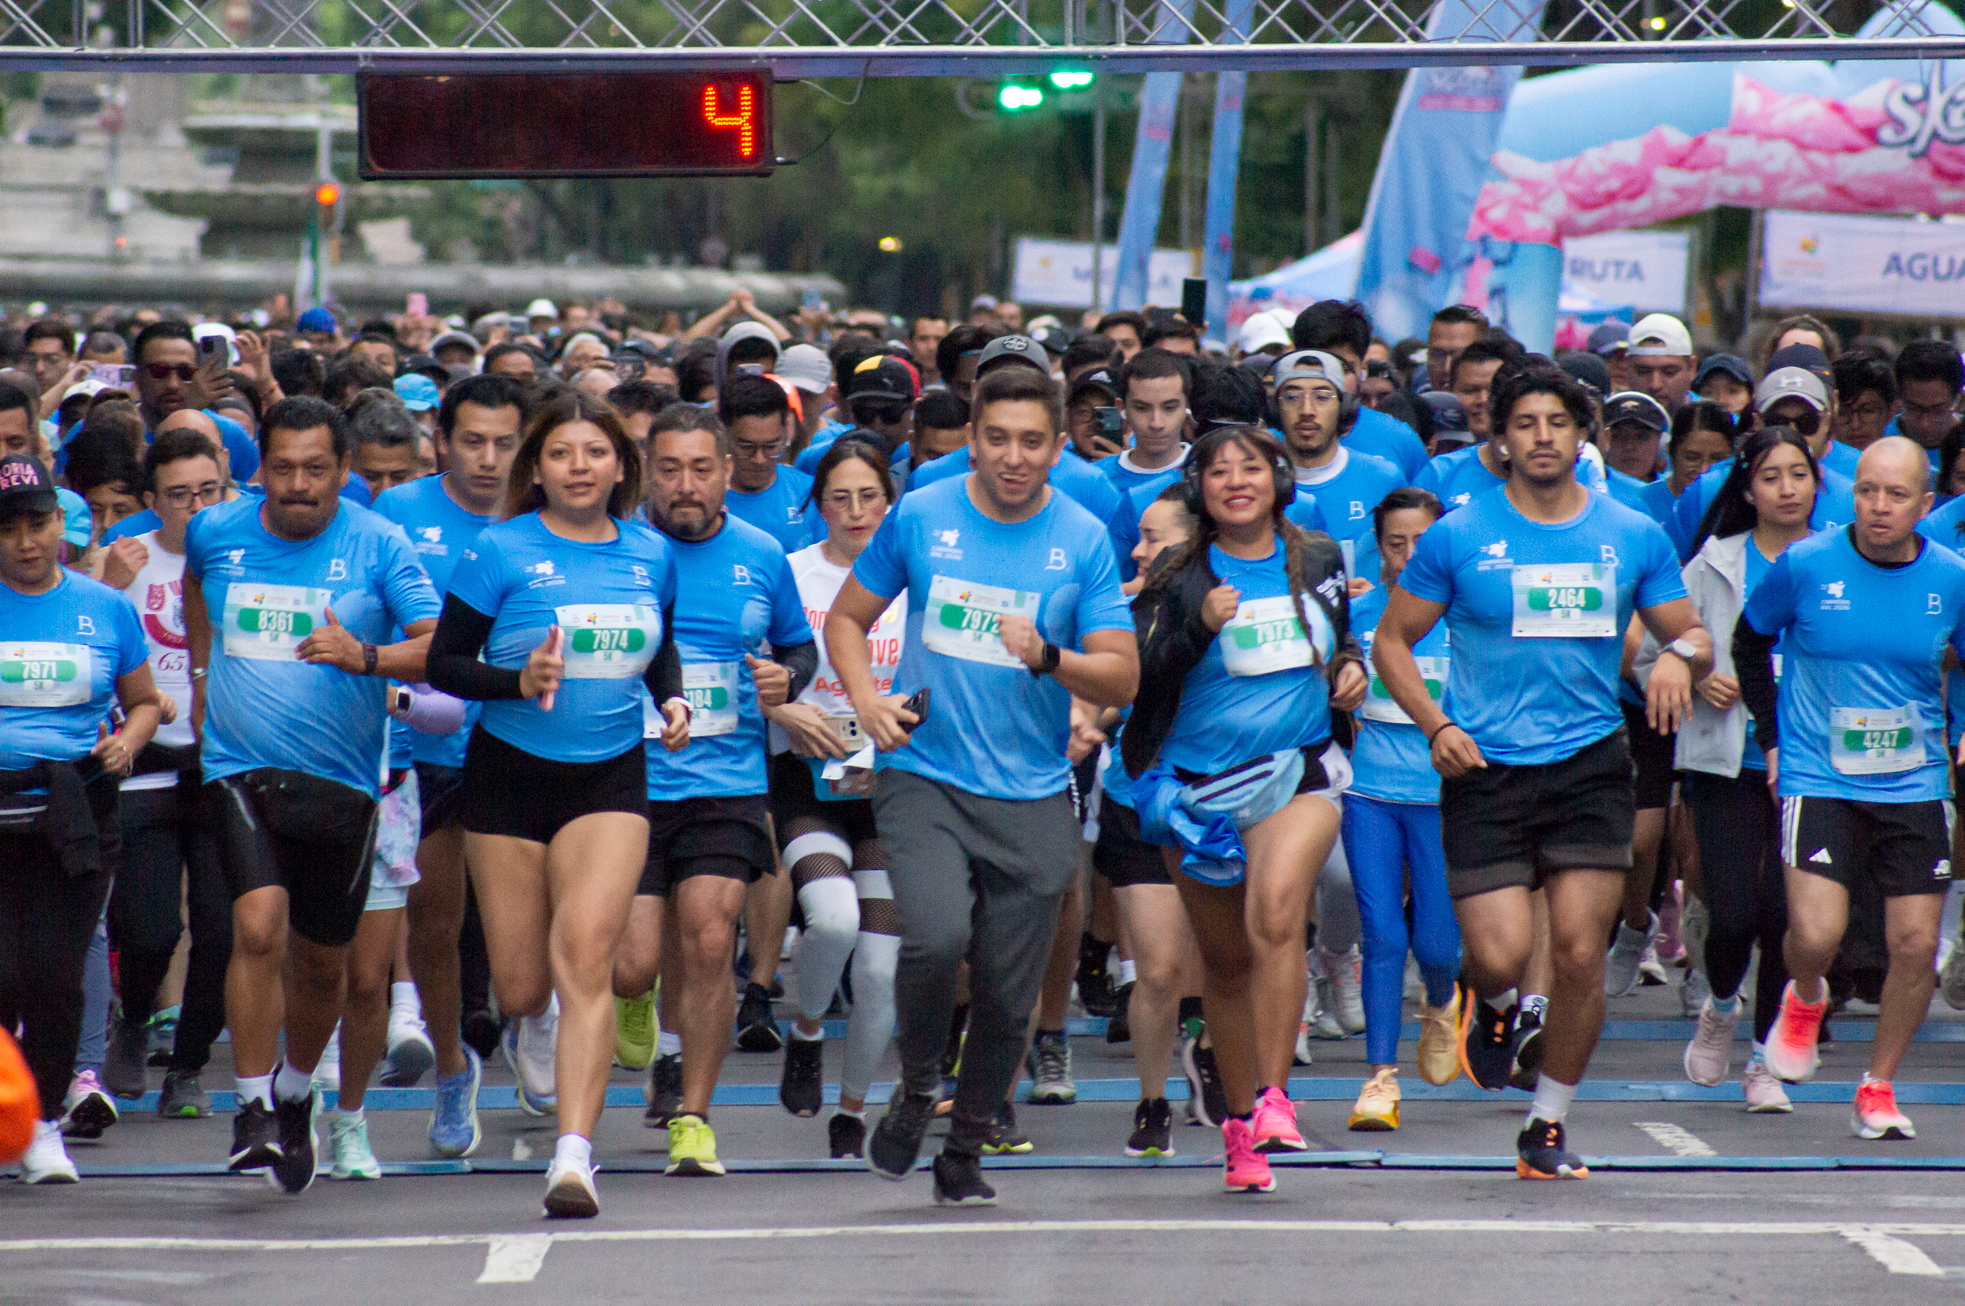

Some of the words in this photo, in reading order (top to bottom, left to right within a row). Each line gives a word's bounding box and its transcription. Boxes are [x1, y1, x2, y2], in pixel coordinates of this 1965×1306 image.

[704, 85, 752, 156] 4
[1569, 258, 1645, 281] RUTA
[326, 558, 347, 581] B
[1045, 548, 1067, 570] B
[733, 564, 751, 586] B
[1548, 588, 1586, 608] 2464
[1925, 593, 1943, 615] B
[76, 615, 96, 636] B
[258, 610, 294, 632] 8361
[961, 608, 1000, 633] 7972
[592, 629, 629, 650] 7974
[1252, 620, 1295, 644] 7973
[22, 661, 57, 680] 7971
[158, 652, 187, 671] 65
[1862, 730, 1899, 749] 4247
